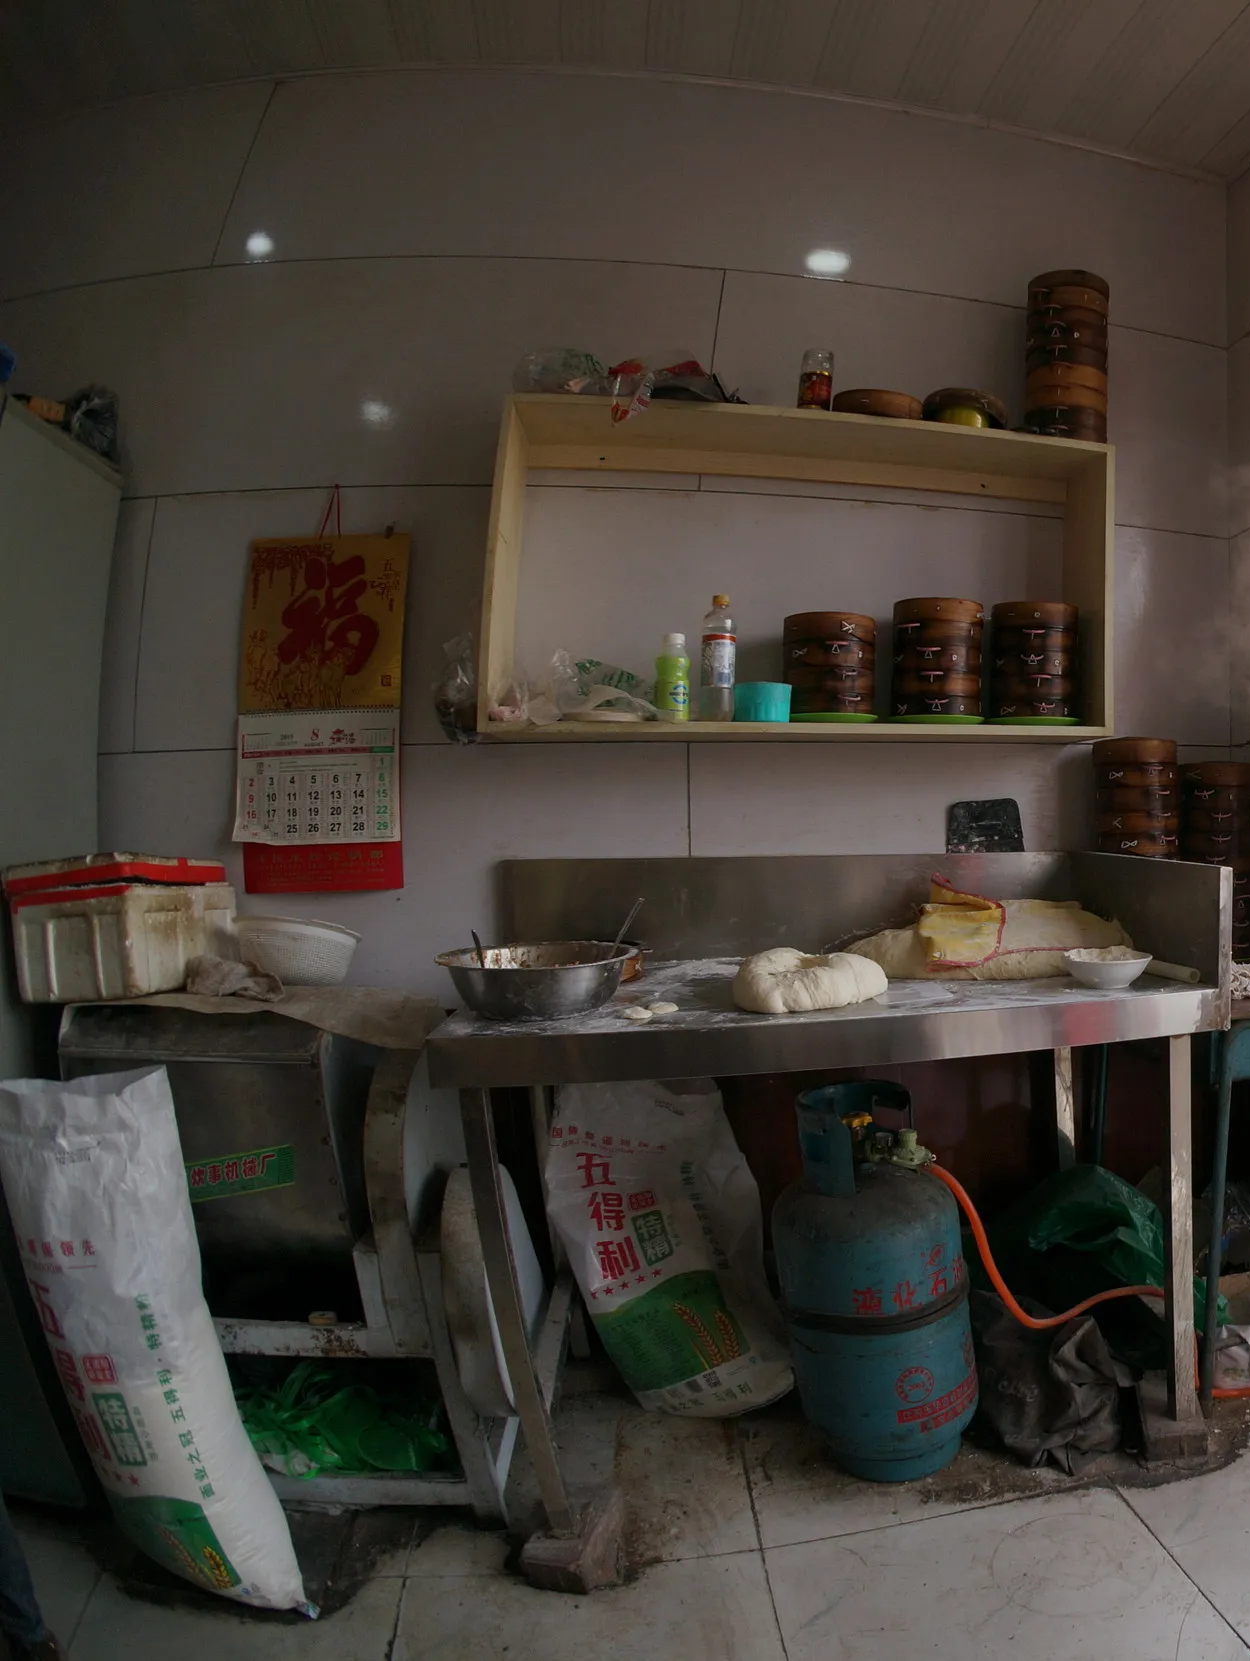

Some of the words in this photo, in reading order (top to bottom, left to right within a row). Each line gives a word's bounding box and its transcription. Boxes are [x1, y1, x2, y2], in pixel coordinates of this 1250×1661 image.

[310, 728, 320, 742] 8
[248, 778, 255, 787] 2
[268, 777, 275, 786] 3
[289, 775, 296, 784] 4
[310, 774, 317, 784] 5
[333, 774, 339, 783] 6
[355, 773, 362, 782] 7
[248, 794, 254, 803] 9
[266, 793, 277, 802] 10
[287, 792, 297, 801] 11
[308, 791, 319, 800] 12
[330, 790, 341, 800] 13
[353, 789, 364, 799] 14
[376, 789, 388, 798] 15
[246, 811, 256, 820] 16
[266, 809, 277, 818] 17
[287, 808, 297, 818] 18
[308, 807, 319, 816] 19
[330, 806, 341, 816] 20
[353, 806, 364, 815] 21
[376, 805, 388, 814] 22
[287, 824, 297, 834] 25
[308, 824, 319, 833] 26
[330, 823, 342, 832] 27
[353, 822, 365, 832] 28
[376, 821, 389, 831] 29
[576, 1152, 641, 1281] 五得利
[636, 1214, 672, 1259] 特精
